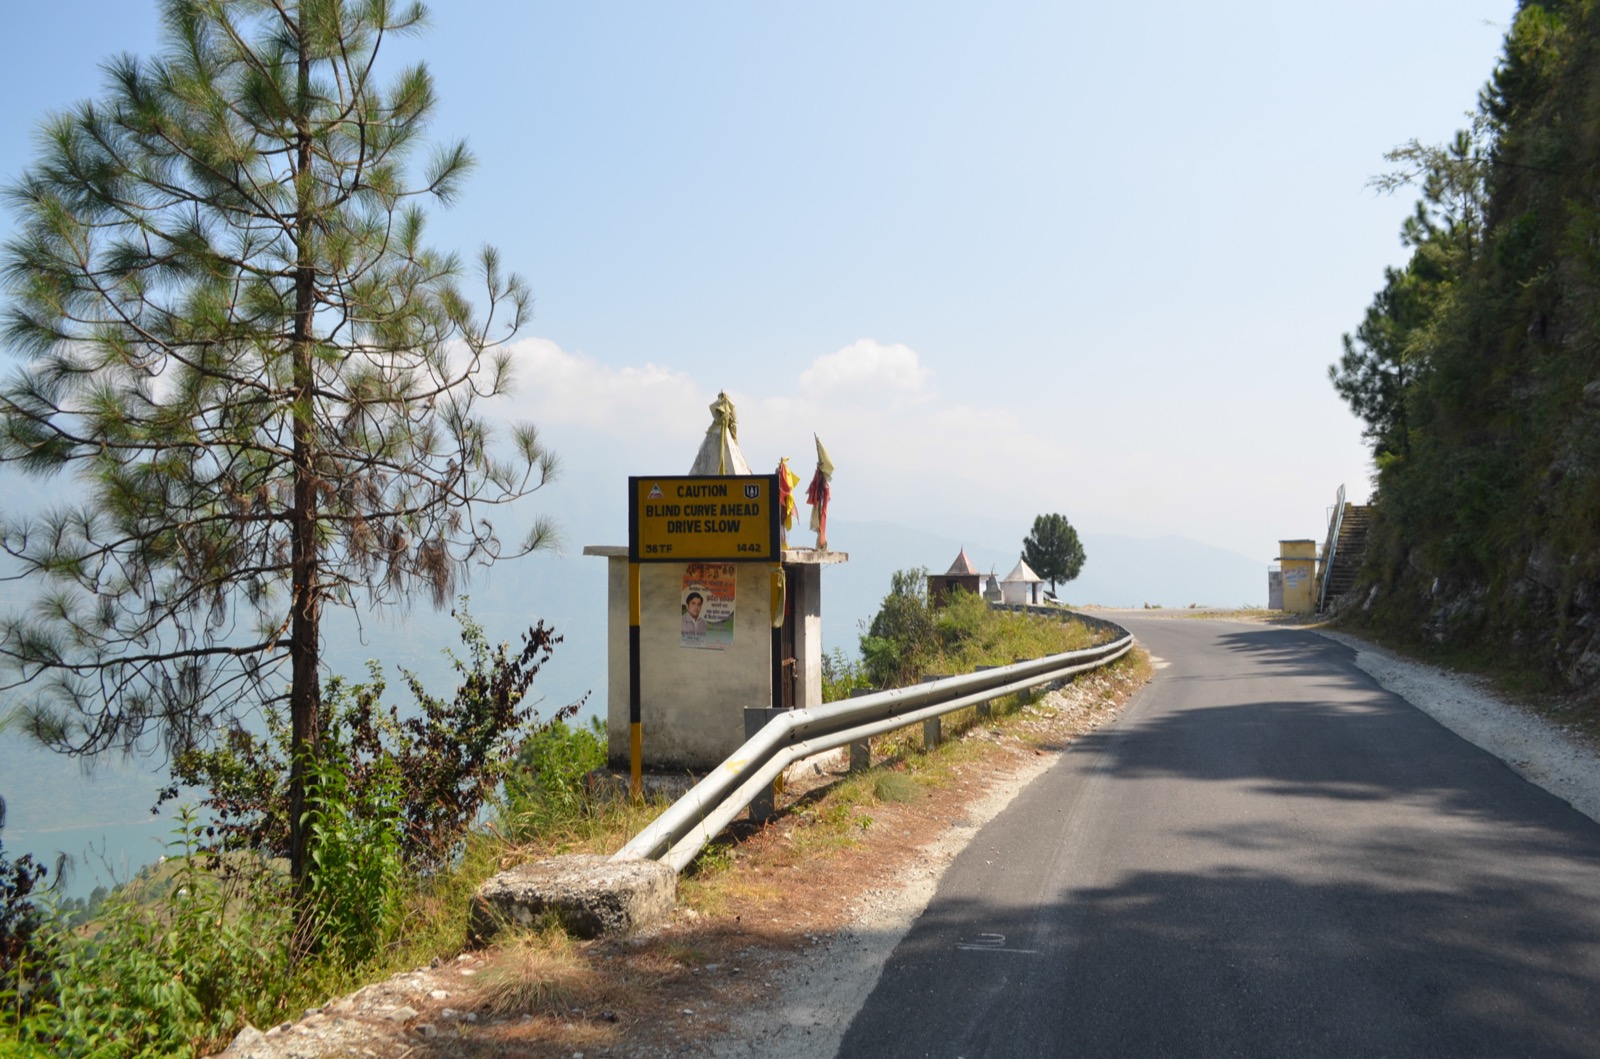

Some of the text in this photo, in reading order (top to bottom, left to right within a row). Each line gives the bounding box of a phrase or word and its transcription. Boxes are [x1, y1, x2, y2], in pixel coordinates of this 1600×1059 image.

[677, 484, 728, 498] CAUTION
[646, 503, 760, 517] BLIND CURVE AHEAD
[667, 520, 741, 533] DRIVE SLOW
[737, 543, 761, 552] 1442
